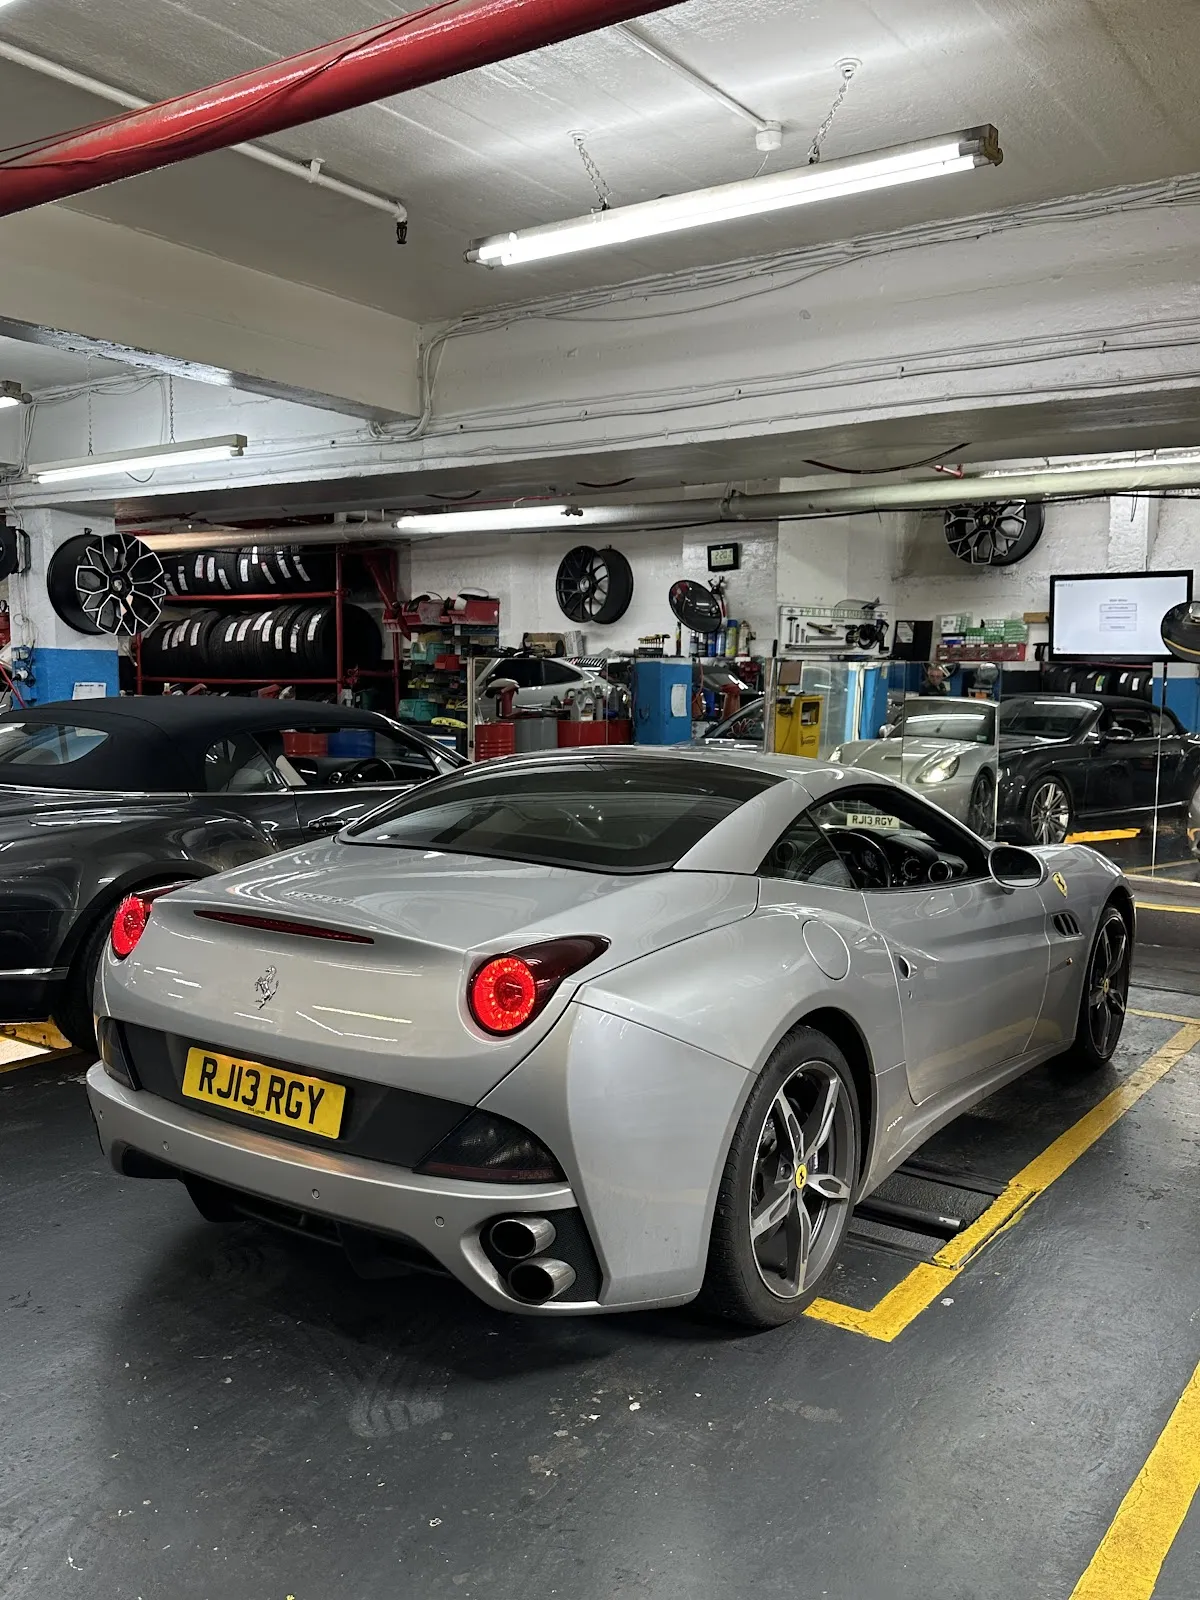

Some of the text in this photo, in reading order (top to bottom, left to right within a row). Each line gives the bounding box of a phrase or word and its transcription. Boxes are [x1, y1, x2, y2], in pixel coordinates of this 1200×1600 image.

[852, 815, 893, 826] RJ13 RGY
[199, 1056, 325, 1125] RJ13 RGY
